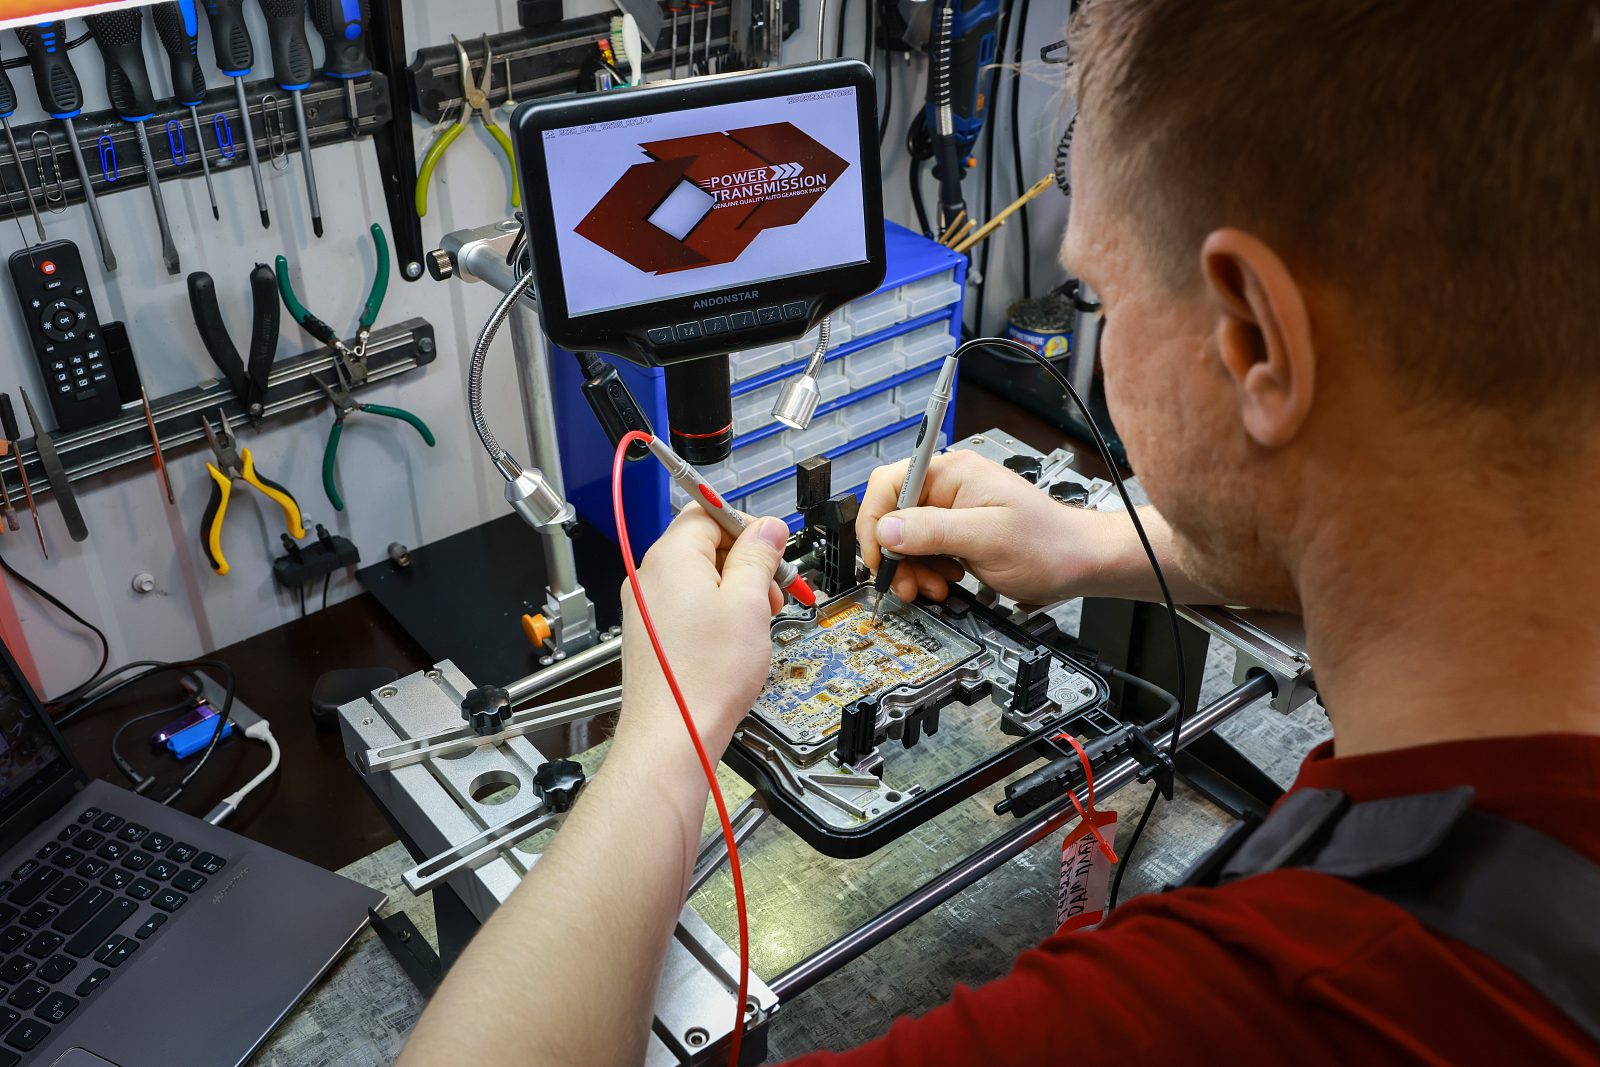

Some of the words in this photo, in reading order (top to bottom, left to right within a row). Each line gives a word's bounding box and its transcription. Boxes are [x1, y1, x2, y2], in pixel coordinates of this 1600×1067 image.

[711, 169, 767, 188] POWER
[711, 173, 827, 203] TRANSMISSION
[713, 201, 739, 210] GENUINE
[740, 196, 764, 205] QUALITY
[765, 193, 781, 201] AUTO
[781, 190, 808, 198] GEARBOX
[809, 186, 827, 194] PARTS
[693, 290, 759, 310] ANDONSTAR
[60, 316, 70, 324] OK
